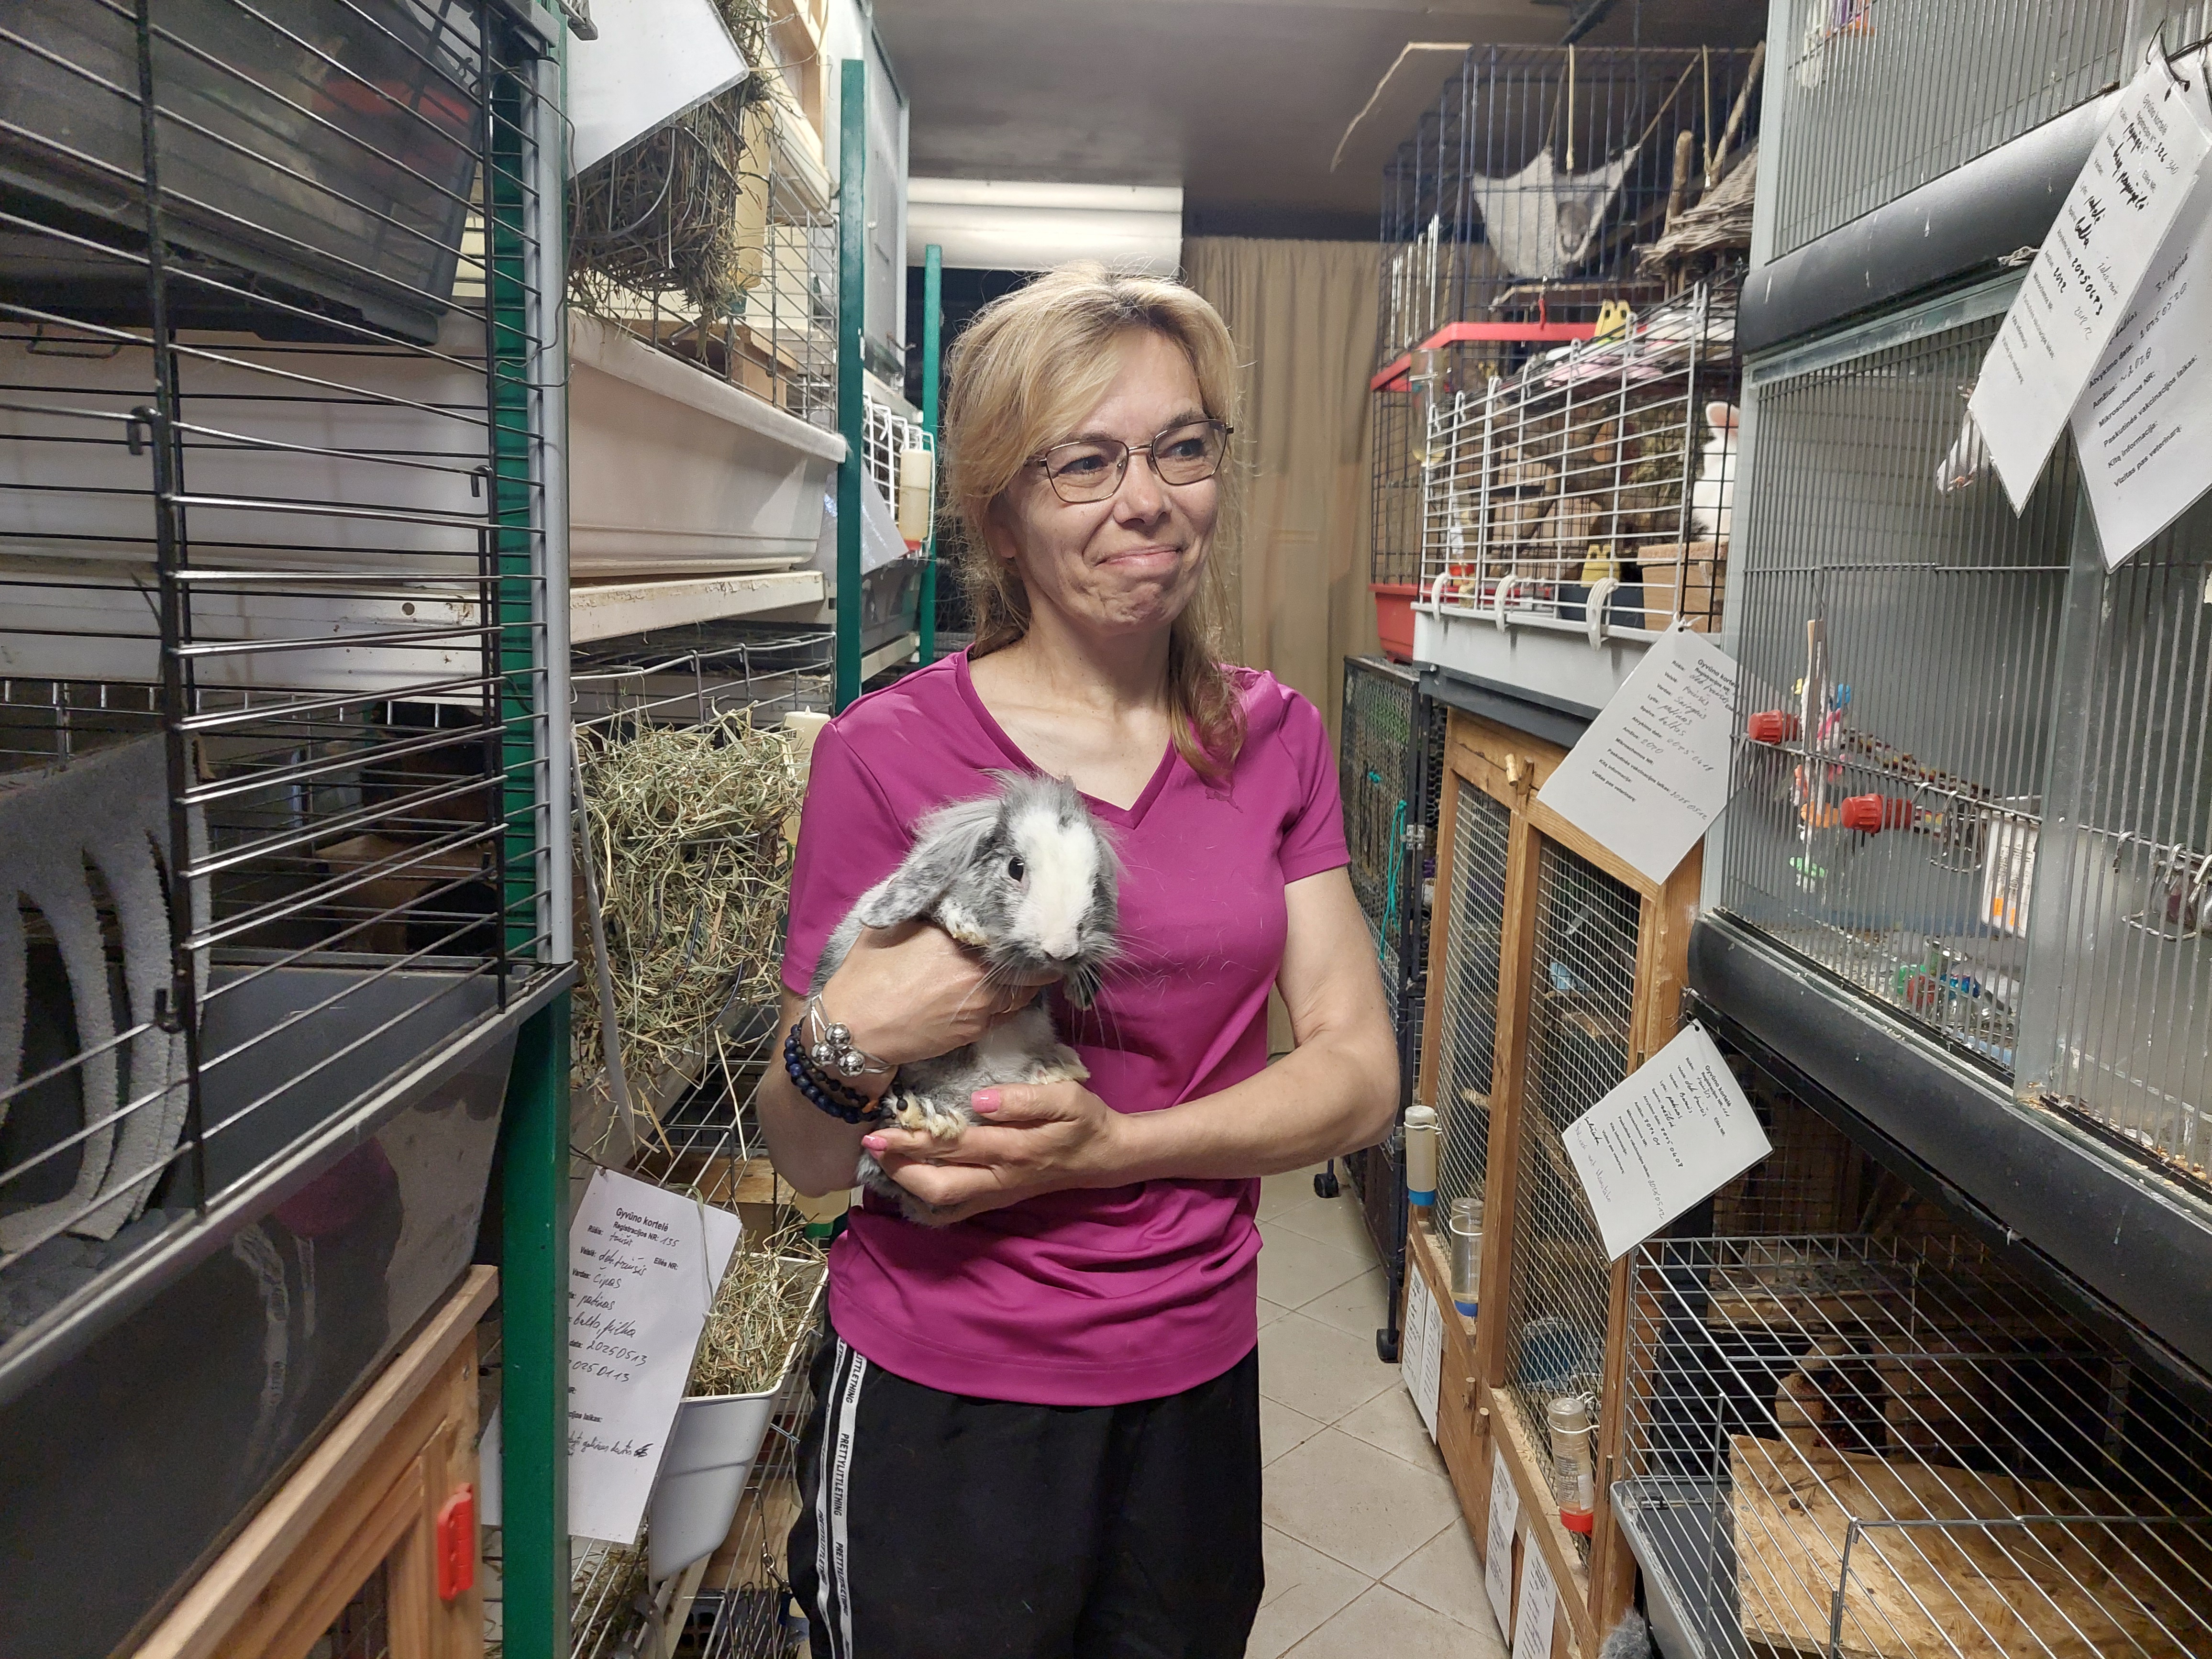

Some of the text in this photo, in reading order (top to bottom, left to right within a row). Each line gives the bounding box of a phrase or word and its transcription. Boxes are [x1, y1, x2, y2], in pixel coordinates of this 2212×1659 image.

[2092, 383, 2118, 409] Amžius:
[2099, 371, 2156, 428] Mikroschemos NR:
[2103, 354, 2198, 447] Paskutinės vakcinacijos laikas:
[2113, 425, 2181, 487] Vizitas pas veterinarą:
[1697, 659, 1720, 676] Gyvūno
[1657, 683, 1671, 697] Vardas:
[1622, 727, 1640, 739] Amžius:
[1631, 717, 1663, 739] Atvykimo data:
[1615, 737, 1654, 765] Mikroschemos NR:
[1607, 748, 1671, 793] Paskutinės vakcinacijos laikas:
[1592, 769, 1606, 782] Vizitas
[1614, 785, 1636, 802] veterinarą:
[1669, 1073, 1680, 1090] Vardas:
[1701, 1071, 1718, 1099] Registracijos
[1705, 1065, 1732, 1107] Gyvūno kortelė
[1602, 1129, 1610, 1145] Vizitas
[613, 1221, 659, 1241] Registracijos NR:
[616, 1207, 669, 1232] Gyvūno kortelė
[653, 1257, 678, 1271] Eilės NR:
[586, 1340, 647, 1366] 20250513
[834, 1433, 849, 1516] PRETTYLITTLETHING
